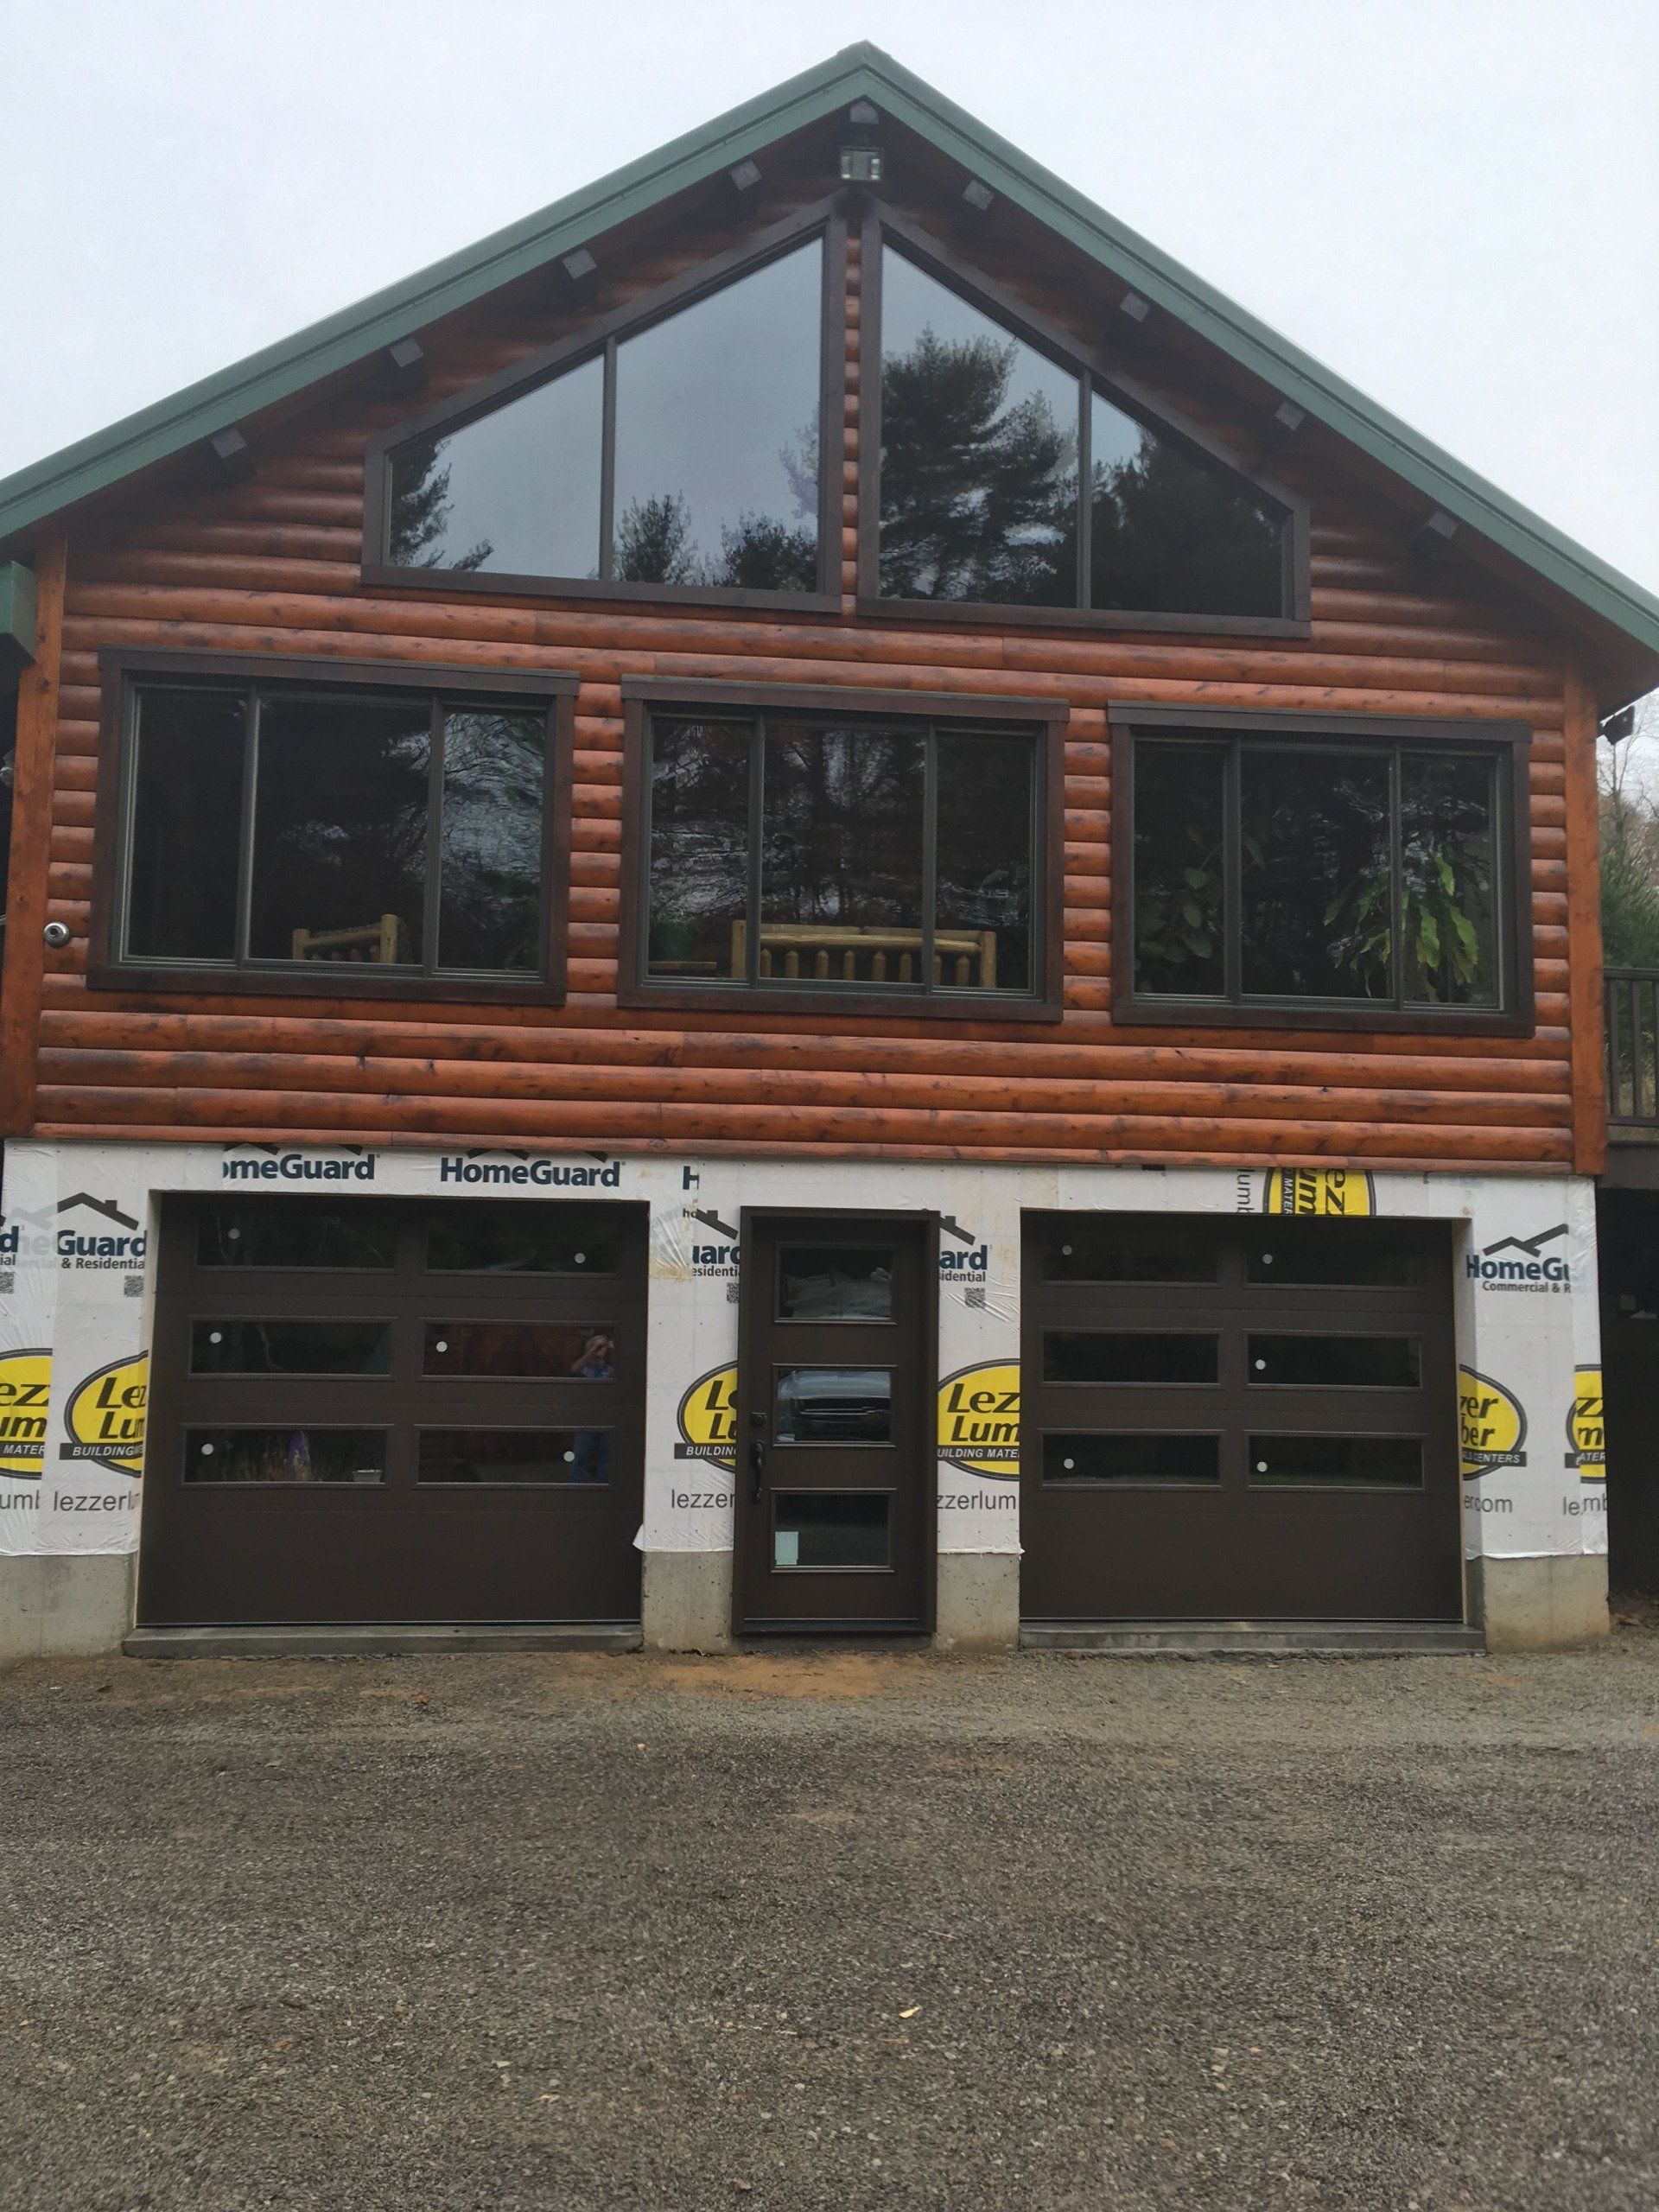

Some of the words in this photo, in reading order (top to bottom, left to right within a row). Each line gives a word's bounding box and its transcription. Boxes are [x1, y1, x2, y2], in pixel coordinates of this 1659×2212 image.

[441, 1157, 620, 1187] HomeGuard
[61, 1258, 71, 1268] &
[1483, 1281, 1548, 1293] Commercial
[1552, 1283, 1560, 1293] &
[947, 1383, 1020, 1414] Lez
[951, 1415, 1020, 1442] Lum
[73, 1446, 134, 1457] BUILDING
